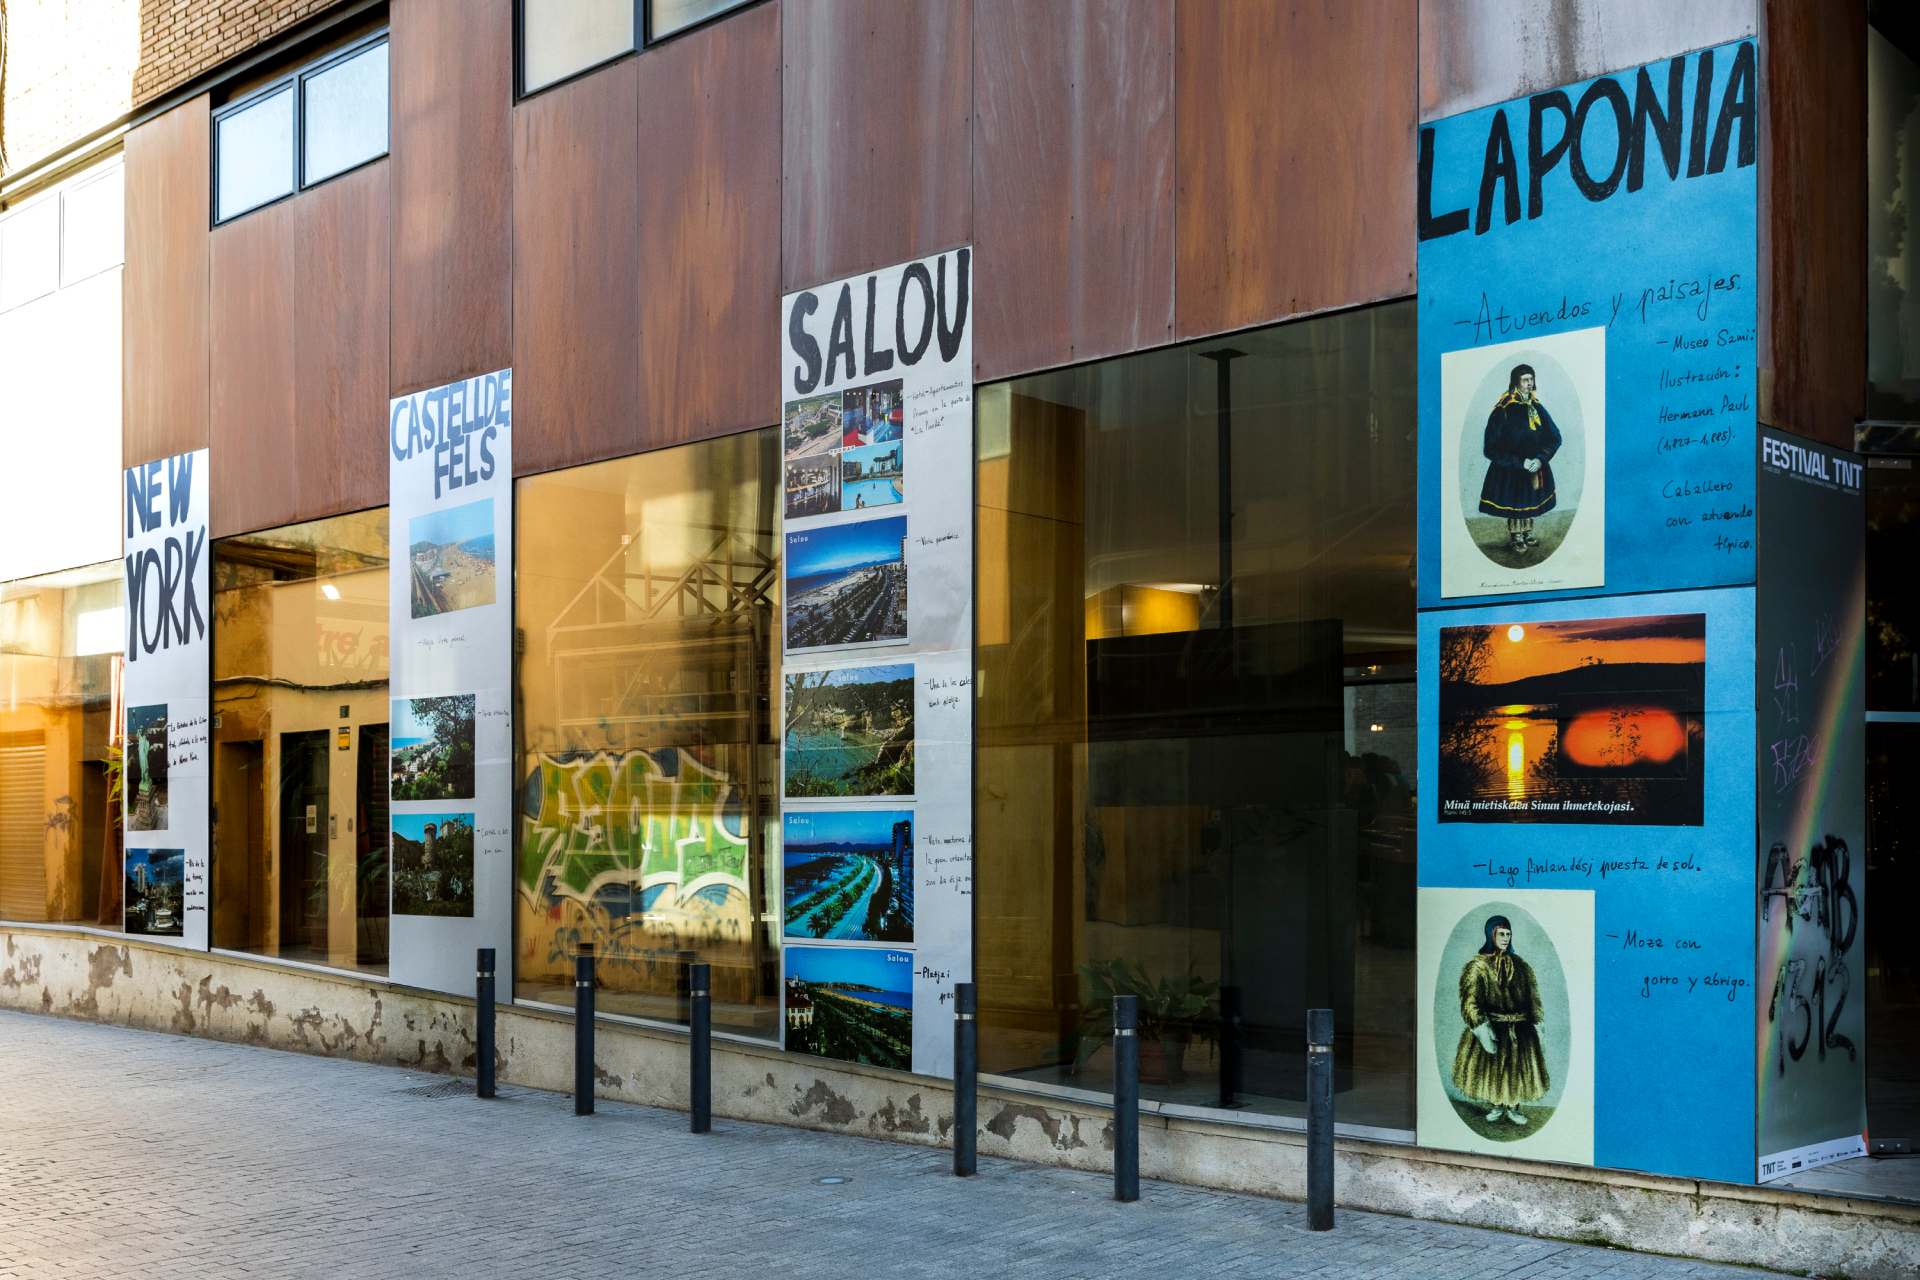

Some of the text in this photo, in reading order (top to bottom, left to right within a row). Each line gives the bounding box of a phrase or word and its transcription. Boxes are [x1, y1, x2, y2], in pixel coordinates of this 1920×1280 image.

[1419, 41, 1755, 242] LAPONIA
[1608, 292, 1623, 329] y
[1639, 273, 1741, 324] paisajes.
[789, 249, 970, 394] SALOU
[1673, 335, 1709, 352] Museo
[391, 370, 511, 461] CASTELLDE
[1658, 394, 1751, 424] Hermann Paul
[434, 426, 497, 499] FELS
[1763, 437, 1829, 480] FESTIVAL
[1832, 458, 1863, 489] TNT
[126, 452, 194, 539] NEW
[1662, 480, 1733, 499] Caballero
[1666, 516, 1692, 527] con
[789, 536, 809, 544] Salou
[126, 524, 206, 662] YORK
[1444, 800, 1635, 815] Minä mietiskelen Sinun ihmetekojasi.
[788, 817, 810, 825] Salou
[1600, 856, 1649, 880] puesta
[1657, 855, 1669, 870] de
[1673, 853, 1702, 872] sol.
[1624, 929, 1664, 949] Moza
[1675, 937, 1701, 949] con
[887, 953, 909, 963] Salou
[1641, 975, 1679, 998] gorro
[1688, 976, 1698, 992] y
[1762, 1161, 1776, 1176] TNT
